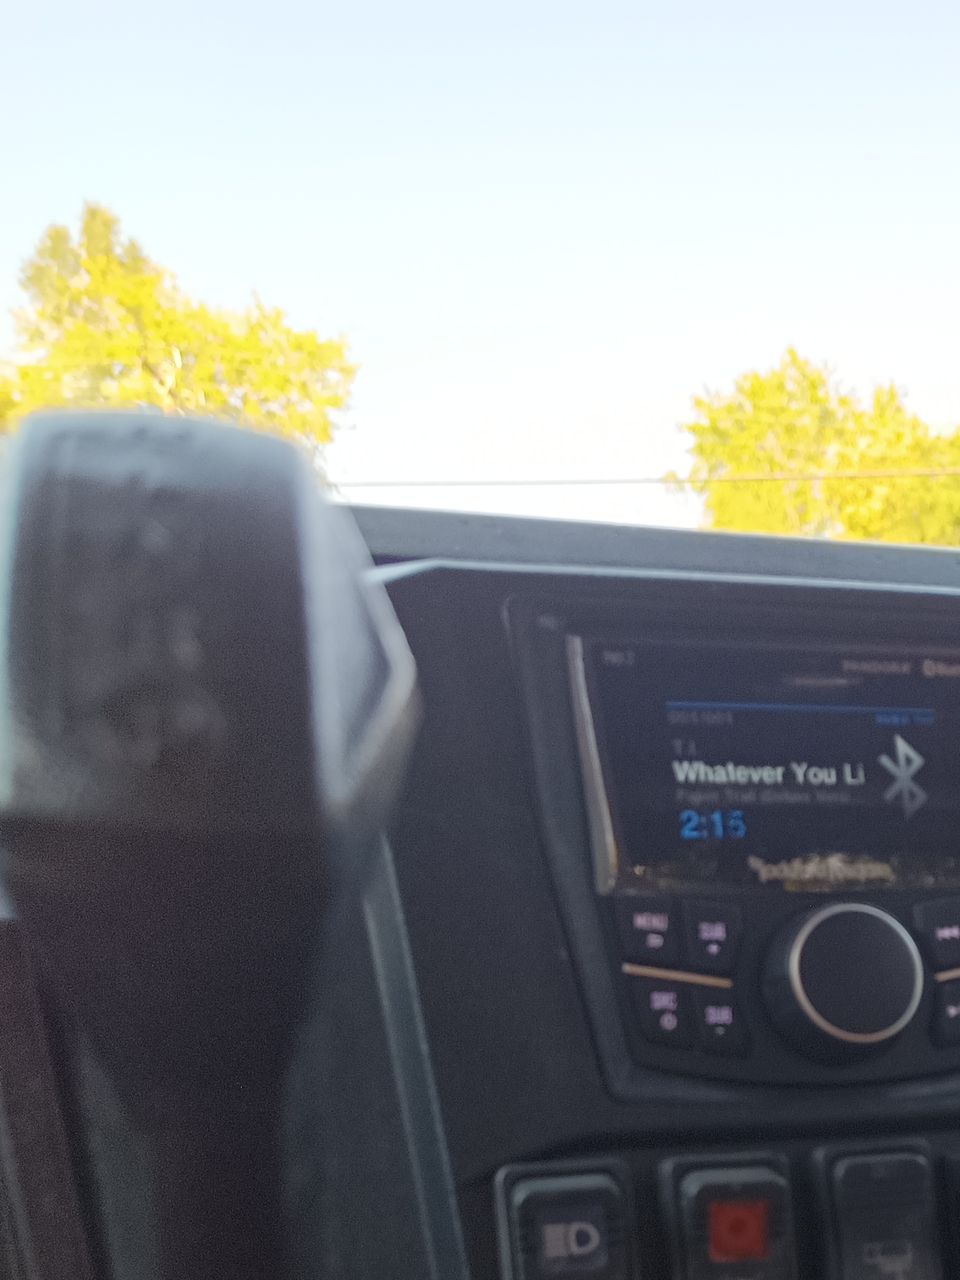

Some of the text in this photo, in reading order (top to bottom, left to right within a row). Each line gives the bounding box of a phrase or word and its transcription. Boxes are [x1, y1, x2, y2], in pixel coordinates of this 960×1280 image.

[673, 760, 865, 786] Whatever You Li
[680, 809, 747, 841] 2:15
